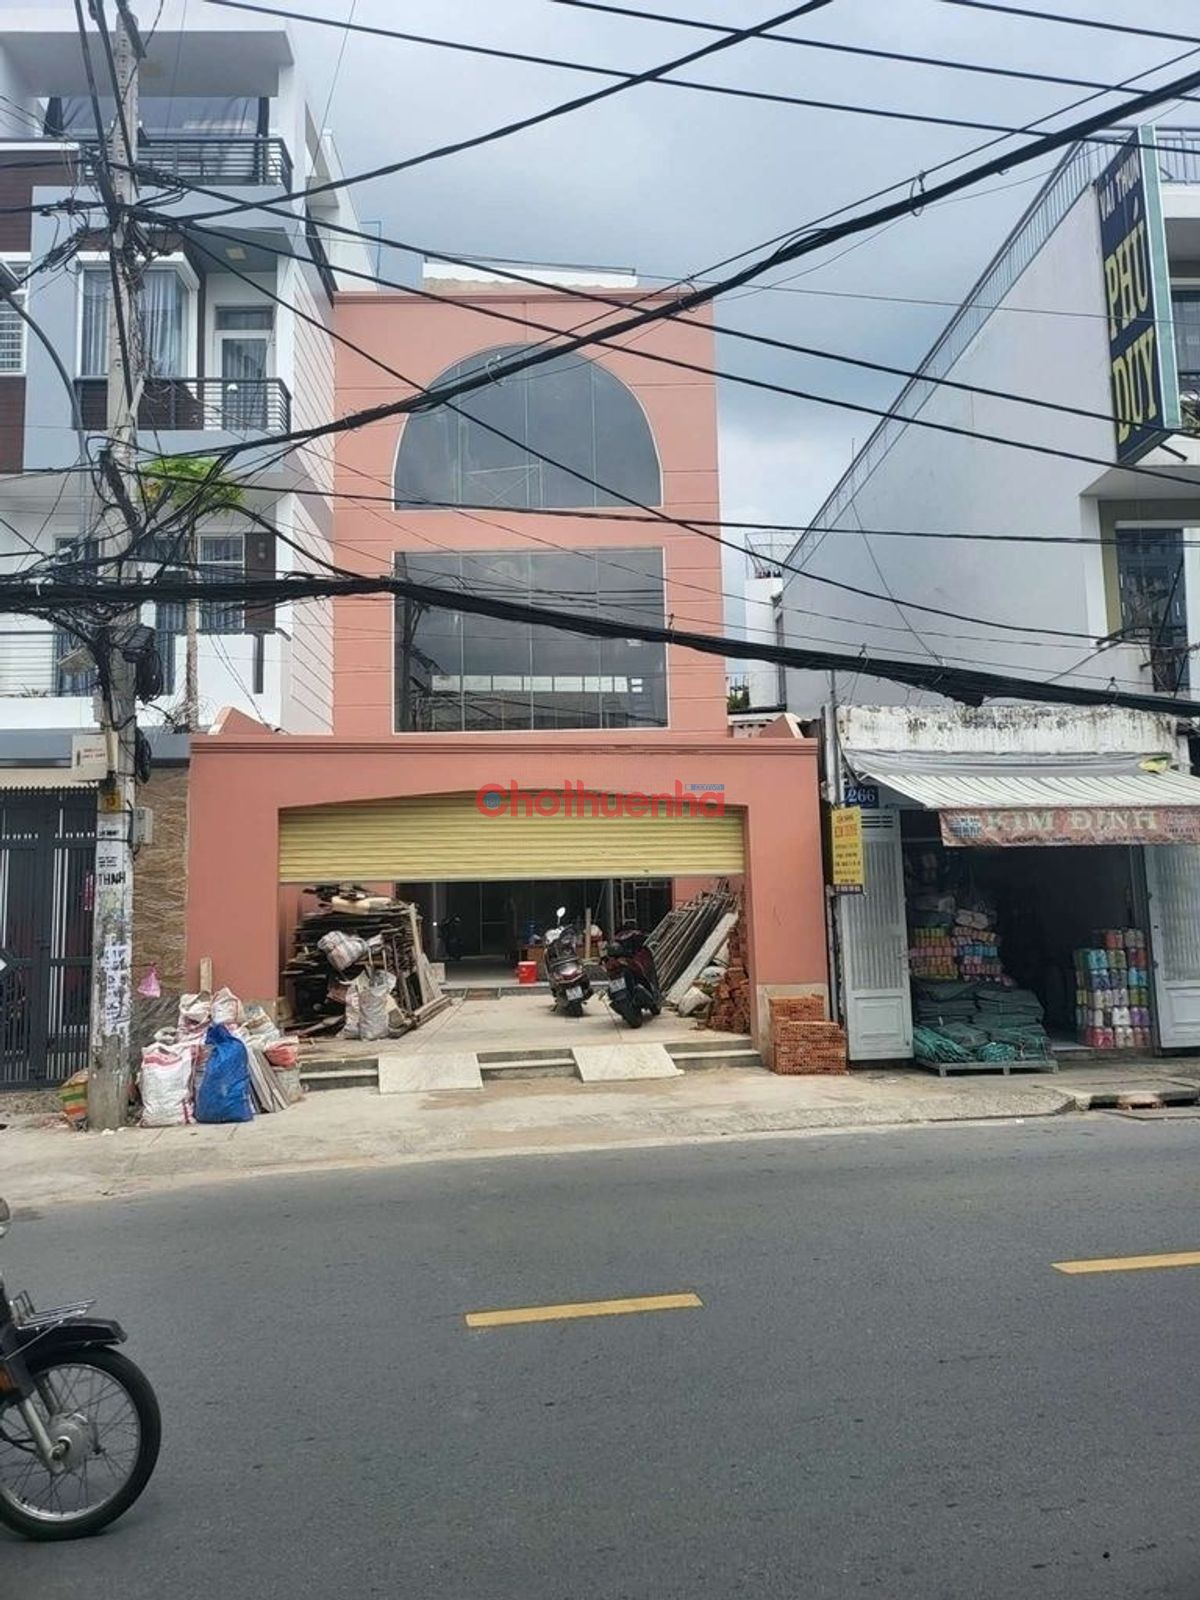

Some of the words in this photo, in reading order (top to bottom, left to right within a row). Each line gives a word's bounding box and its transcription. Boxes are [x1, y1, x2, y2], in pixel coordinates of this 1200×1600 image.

[1104, 196, 1149, 342] PHÚ
[1112, 325, 1157, 445] DUY
[847, 787, 876, 803] 266
[986, 810, 1056, 832] KIM
